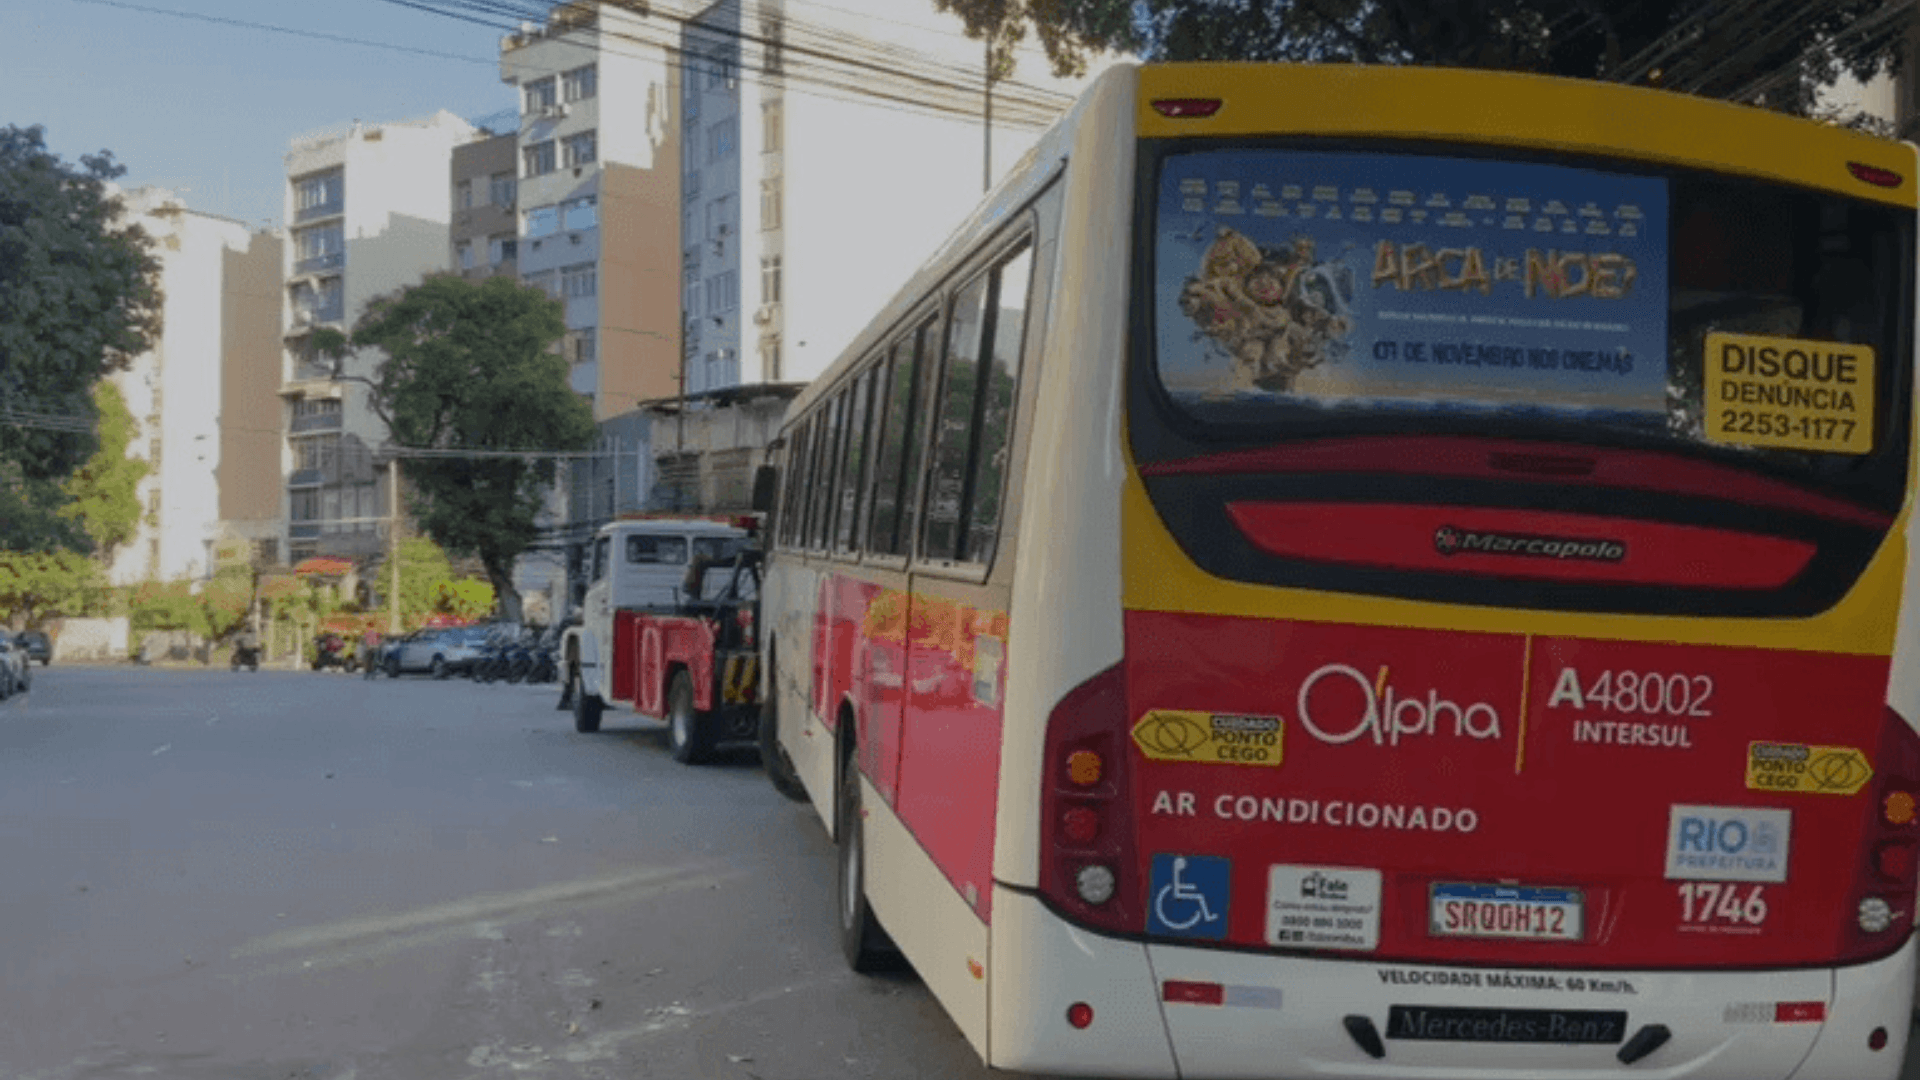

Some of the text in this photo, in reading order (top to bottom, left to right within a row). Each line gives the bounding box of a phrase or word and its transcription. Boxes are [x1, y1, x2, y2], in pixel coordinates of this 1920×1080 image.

[1370, 240, 1491, 296] ARCA
[1403, 341, 1427, 362] DE
[1431, 342, 1524, 369] NOVEMBRO
[1527, 347, 1559, 370] NOS
[1562, 348, 1634, 376] CINEMAS
[1721, 343, 1857, 384] DISQUE
[1721, 379, 1855, 412] DENÚNCIA
[1721, 409, 1856, 442] 2253-1177
[1463, 533, 1624, 559] Marcopolo
[1211, 730, 1278, 746] PONTO
[1573, 719, 1692, 748] INTERSUL
[1217, 745, 1269, 761] CEGO
[1751, 759, 1806, 774] PONTO
[1756, 773, 1799, 788] CEGO
[1152, 790, 1478, 833] AR CONDICIONADO
[1678, 817, 1748, 854] RIO
[1676, 854, 1777, 870] PREFEITURA
[1678, 882, 1768, 925] 1746
[1378, 969, 1482, 988] VELOCIDADE
[1566, 979, 1585, 992] 60
[1400, 1010, 1616, 1041] Mercedes-Benz
